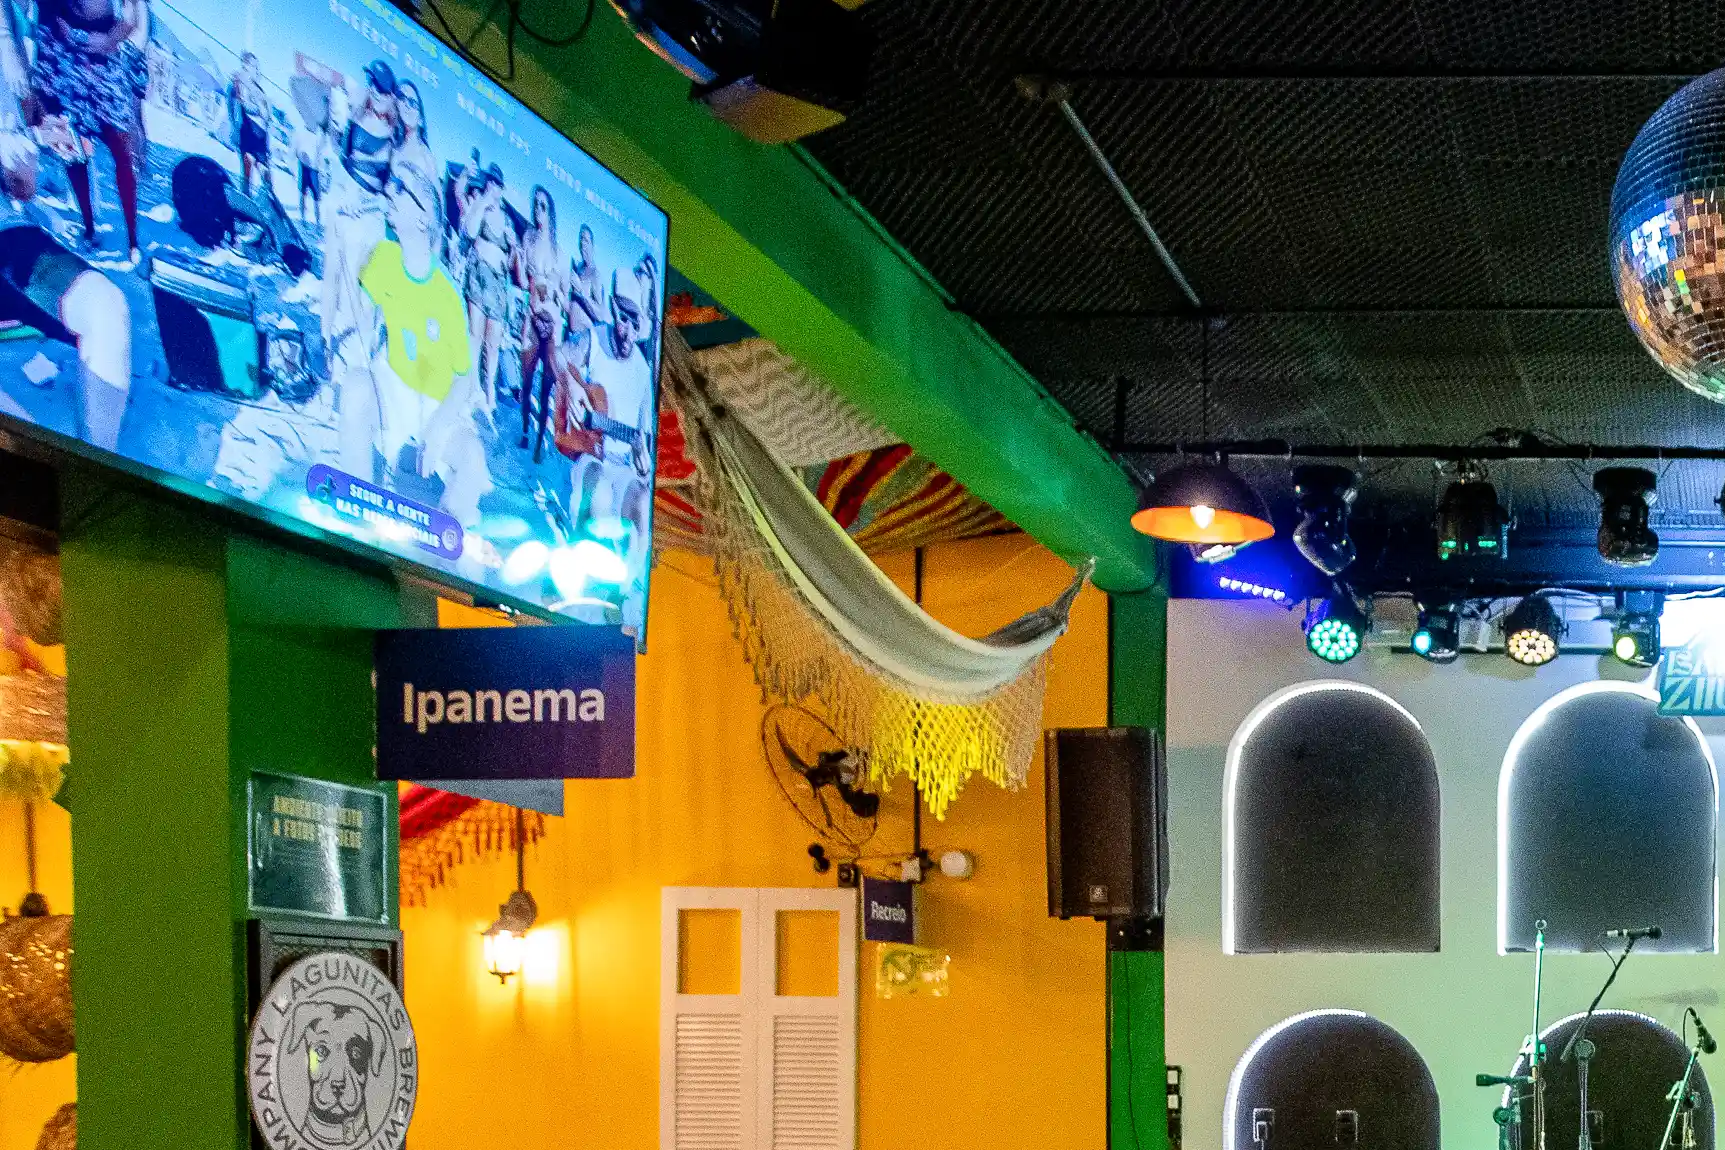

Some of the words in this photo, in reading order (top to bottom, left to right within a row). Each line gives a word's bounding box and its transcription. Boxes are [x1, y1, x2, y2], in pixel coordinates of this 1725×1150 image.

[403, 682, 605, 734] Ipanema
[871, 900, 906, 923] Recreio
[271, 959, 406, 1032] LAGUNITAS
